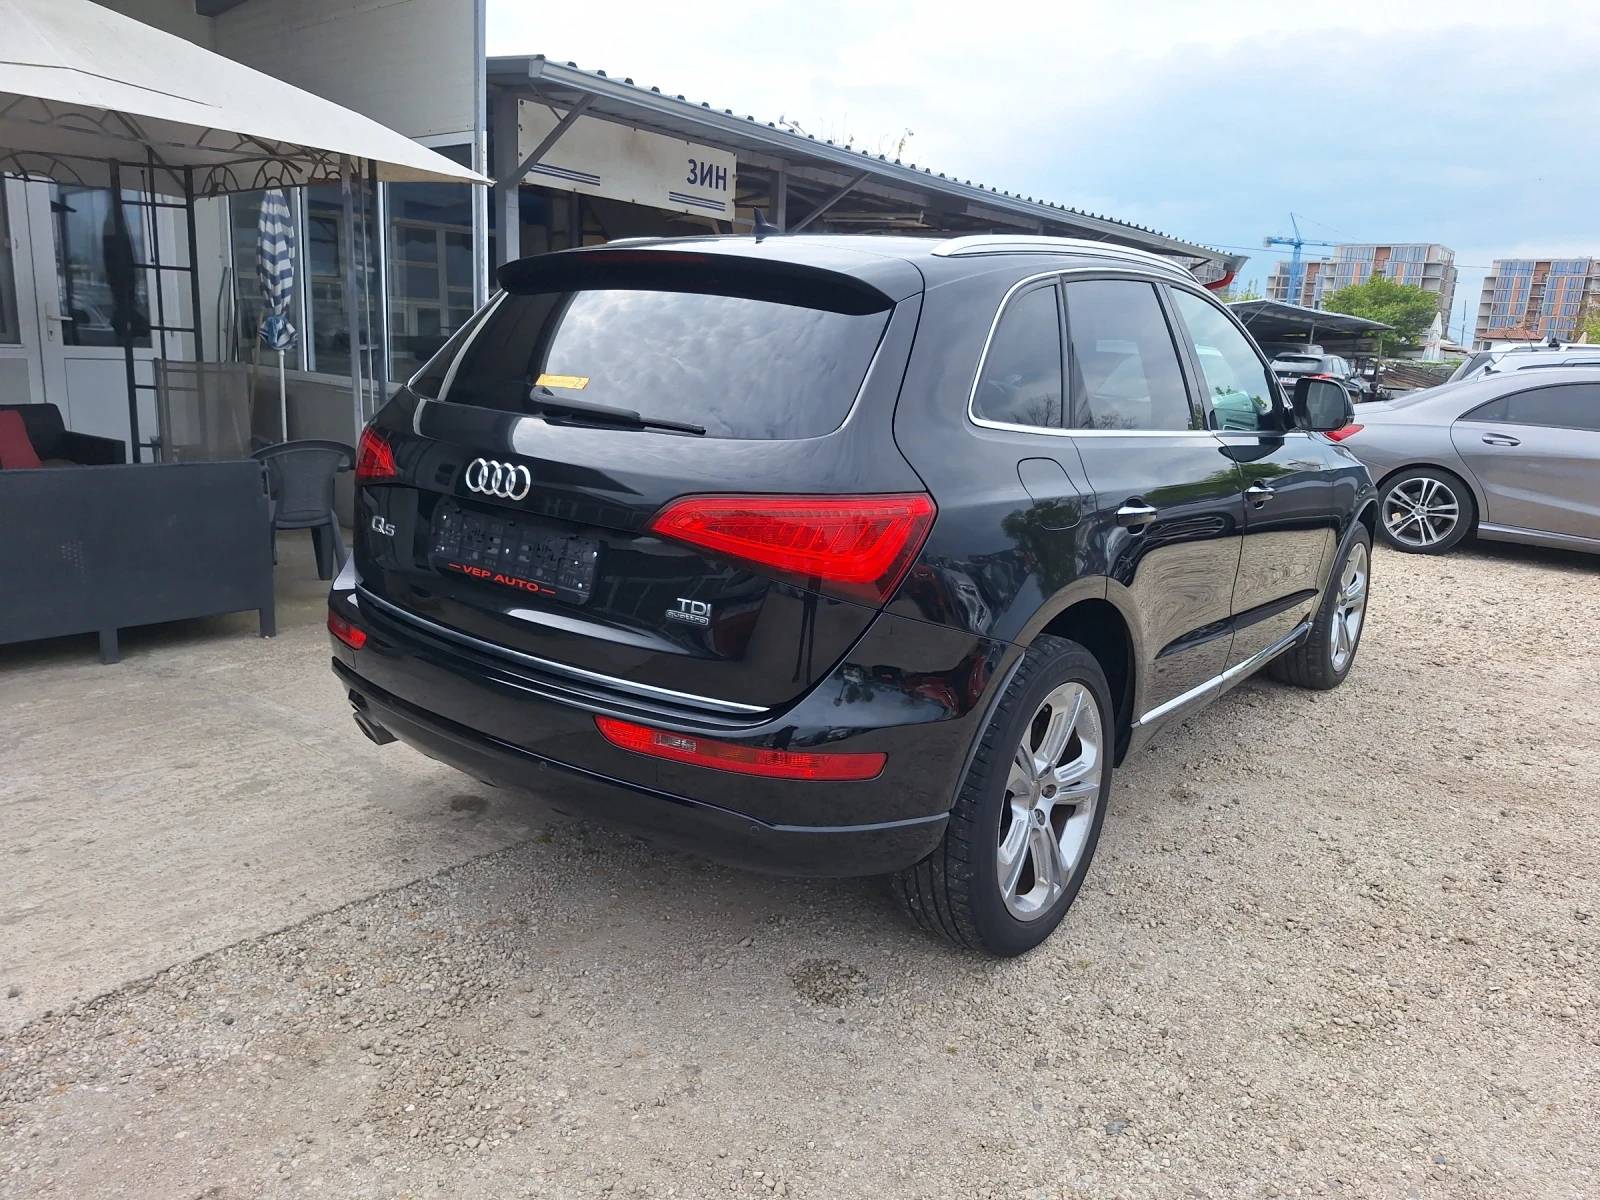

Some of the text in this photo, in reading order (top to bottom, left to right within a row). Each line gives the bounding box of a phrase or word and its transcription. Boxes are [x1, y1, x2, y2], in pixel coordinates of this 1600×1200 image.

[687, 158, 727, 191] ЗИН
[371, 515, 396, 536] Q5
[463, 564, 539, 592] VEP AUTO
[677, 597, 711, 617] TDI
